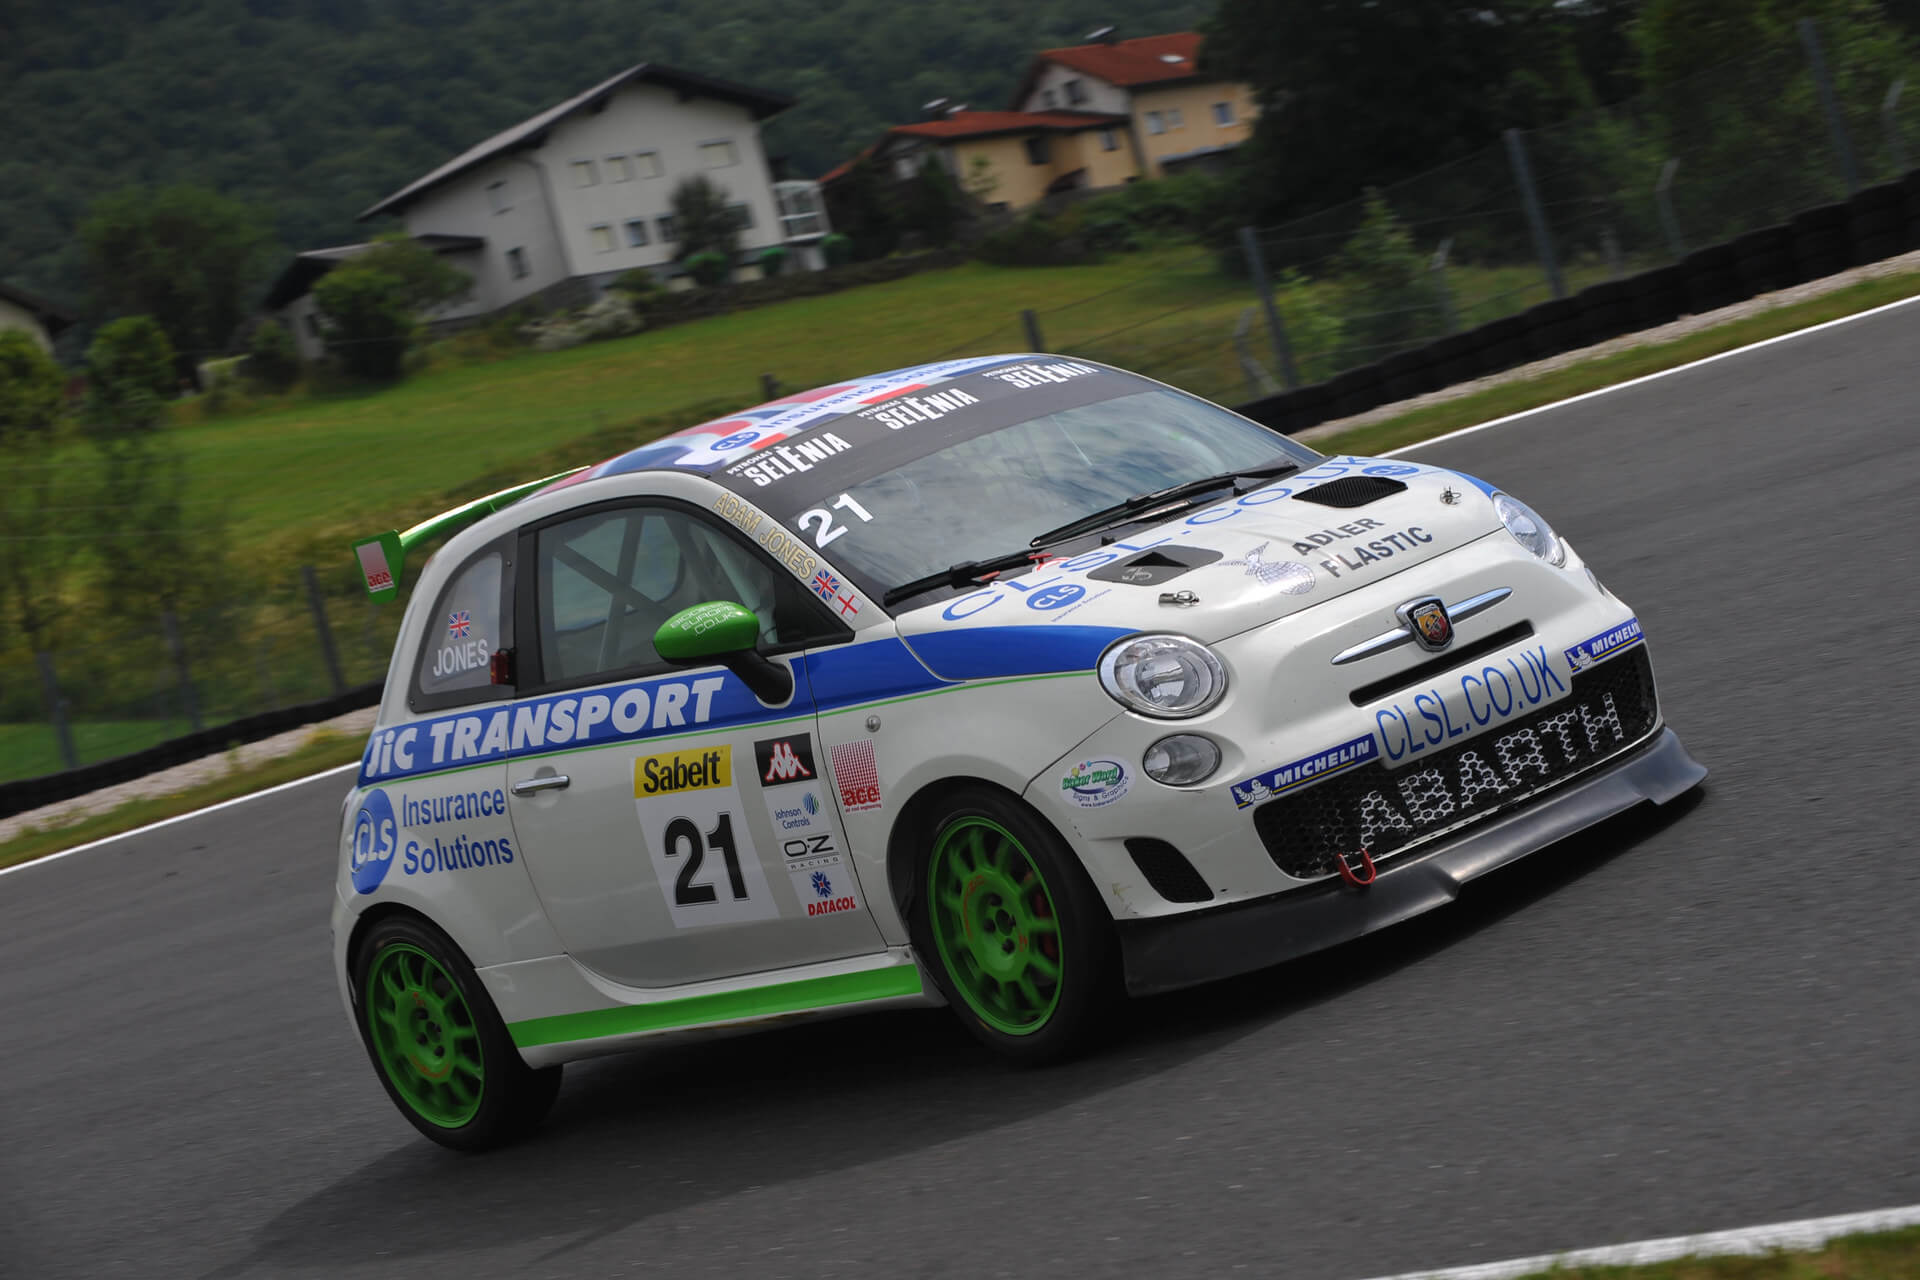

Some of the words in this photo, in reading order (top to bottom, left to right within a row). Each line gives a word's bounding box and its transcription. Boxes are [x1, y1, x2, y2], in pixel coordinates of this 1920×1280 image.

[714, 430, 759, 451] CLS
[760, 384, 888, 428] Insurance
[856, 400, 901, 418] PETRONAS
[726, 450, 772, 475] PETRONAS
[712, 492, 763, 534] ADAM
[759, 527, 816, 579] JONES
[798, 493, 874, 549] 21
[1292, 518, 1384, 556] ADLER
[1035, 585, 1081, 610] CLS
[1591, 622, 1641, 653] MICHELIN
[433, 639, 489, 676] JONES
[430, 677, 724, 764] TRANSPORT
[1376, 645, 1565, 761] CLSL.CO.UK
[644, 751, 720, 793] Sabelt
[1273, 739, 1371, 787] MICHELIN
[1361, 692, 1623, 848] ABARTH
[402, 788, 505, 828] Insurance
[775, 807, 802, 821] Johnson
[844, 786, 878, 806] ace
[782, 817, 810, 830] Controls
[403, 835, 514, 876] Solutions
[664, 813, 749, 905] 21
[791, 857, 838, 869] RACING
[808, 896, 856, 916] DATACOL
